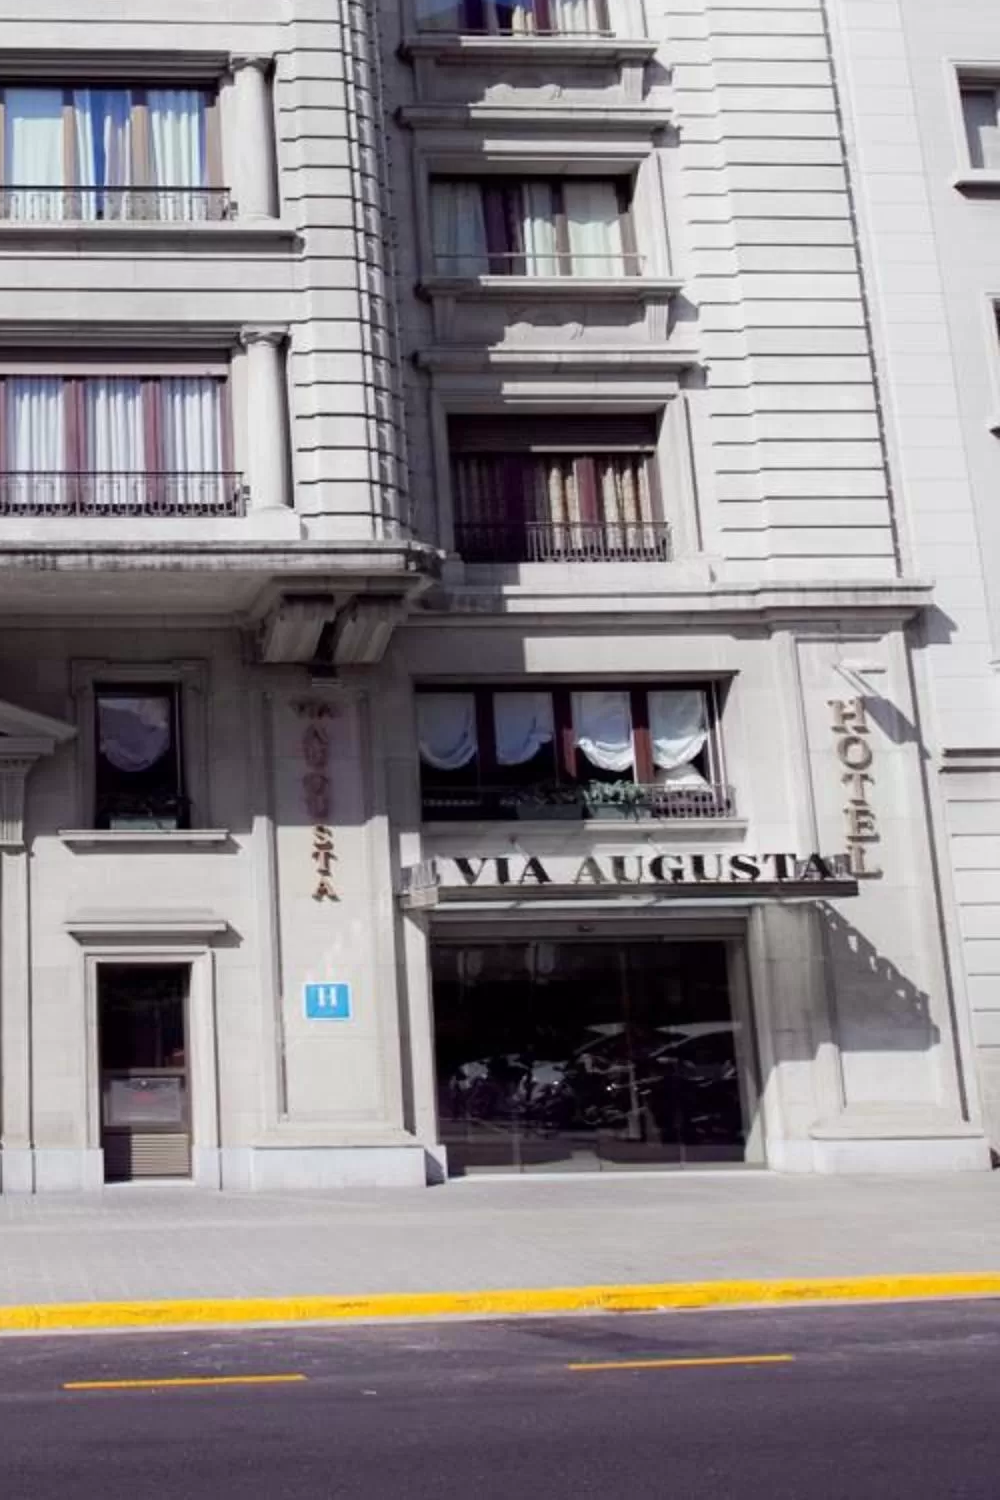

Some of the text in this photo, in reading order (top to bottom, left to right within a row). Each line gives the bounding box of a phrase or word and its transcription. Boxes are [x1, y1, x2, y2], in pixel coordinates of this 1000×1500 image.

[826, 695, 884, 880] HOTEL
[453, 856, 552, 885] VIA
[572, 852, 836, 884] AUGUSTA
[318, 986, 337, 1007] H
